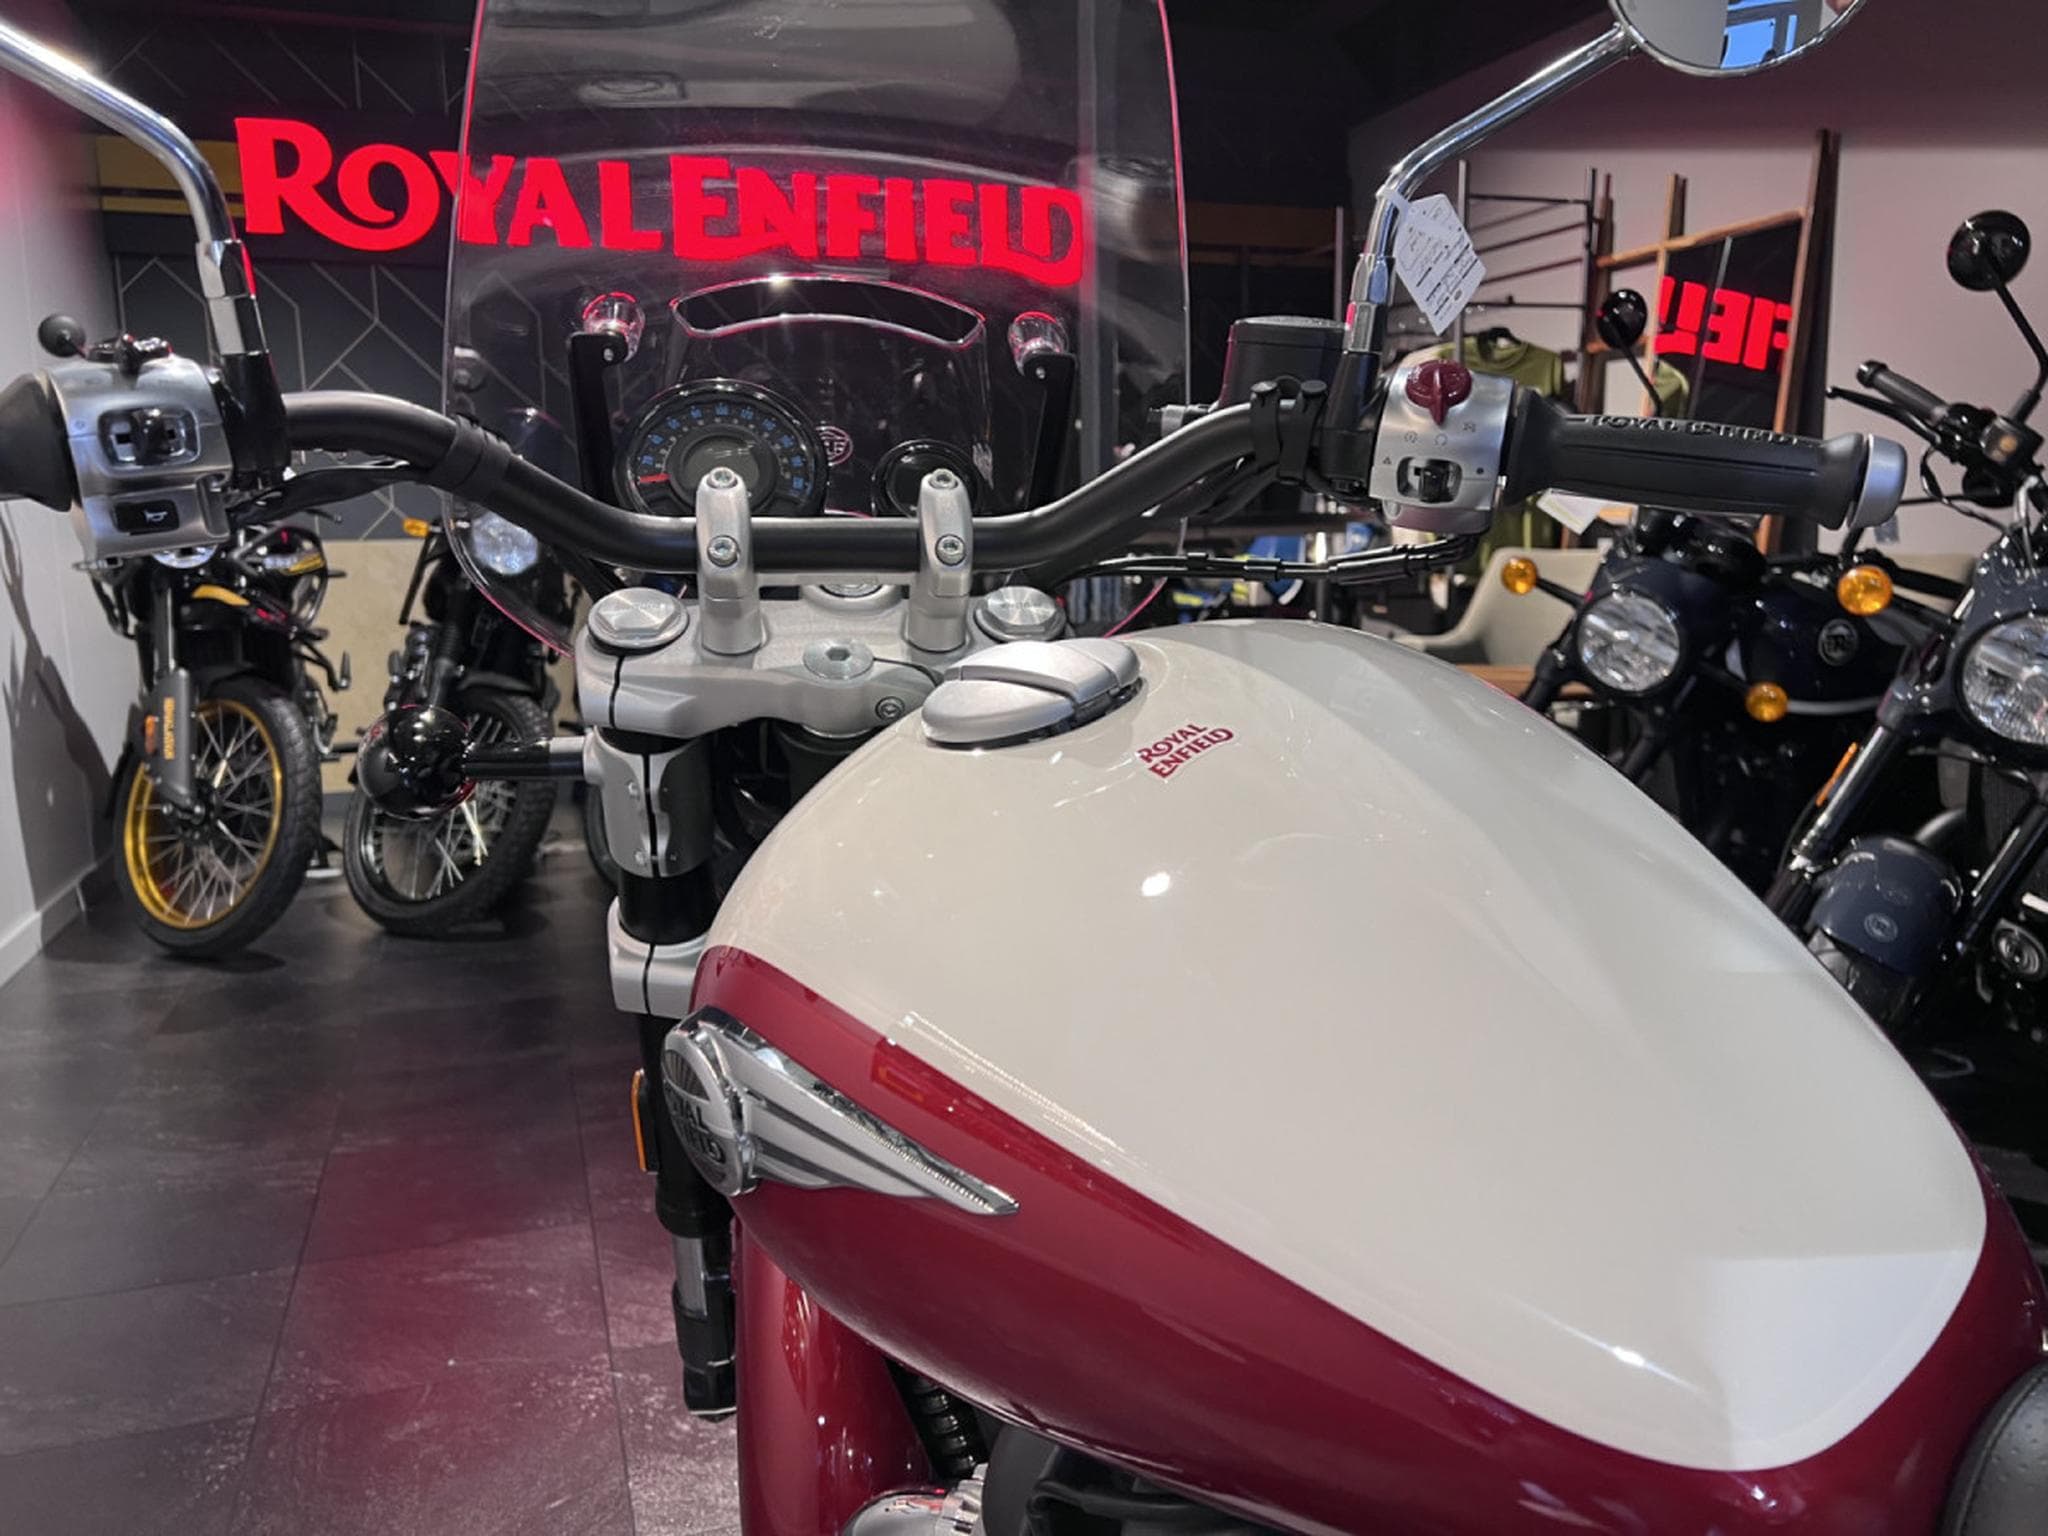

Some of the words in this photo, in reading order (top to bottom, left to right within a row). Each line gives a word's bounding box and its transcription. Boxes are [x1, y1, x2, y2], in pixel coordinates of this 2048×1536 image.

[236, 117, 662, 251] ROYAL
[670, 155, 1087, 286] ENFIELD
[1137, 723, 1208, 764] ROYAL
[1149, 727, 1234, 779] ENFIELD
